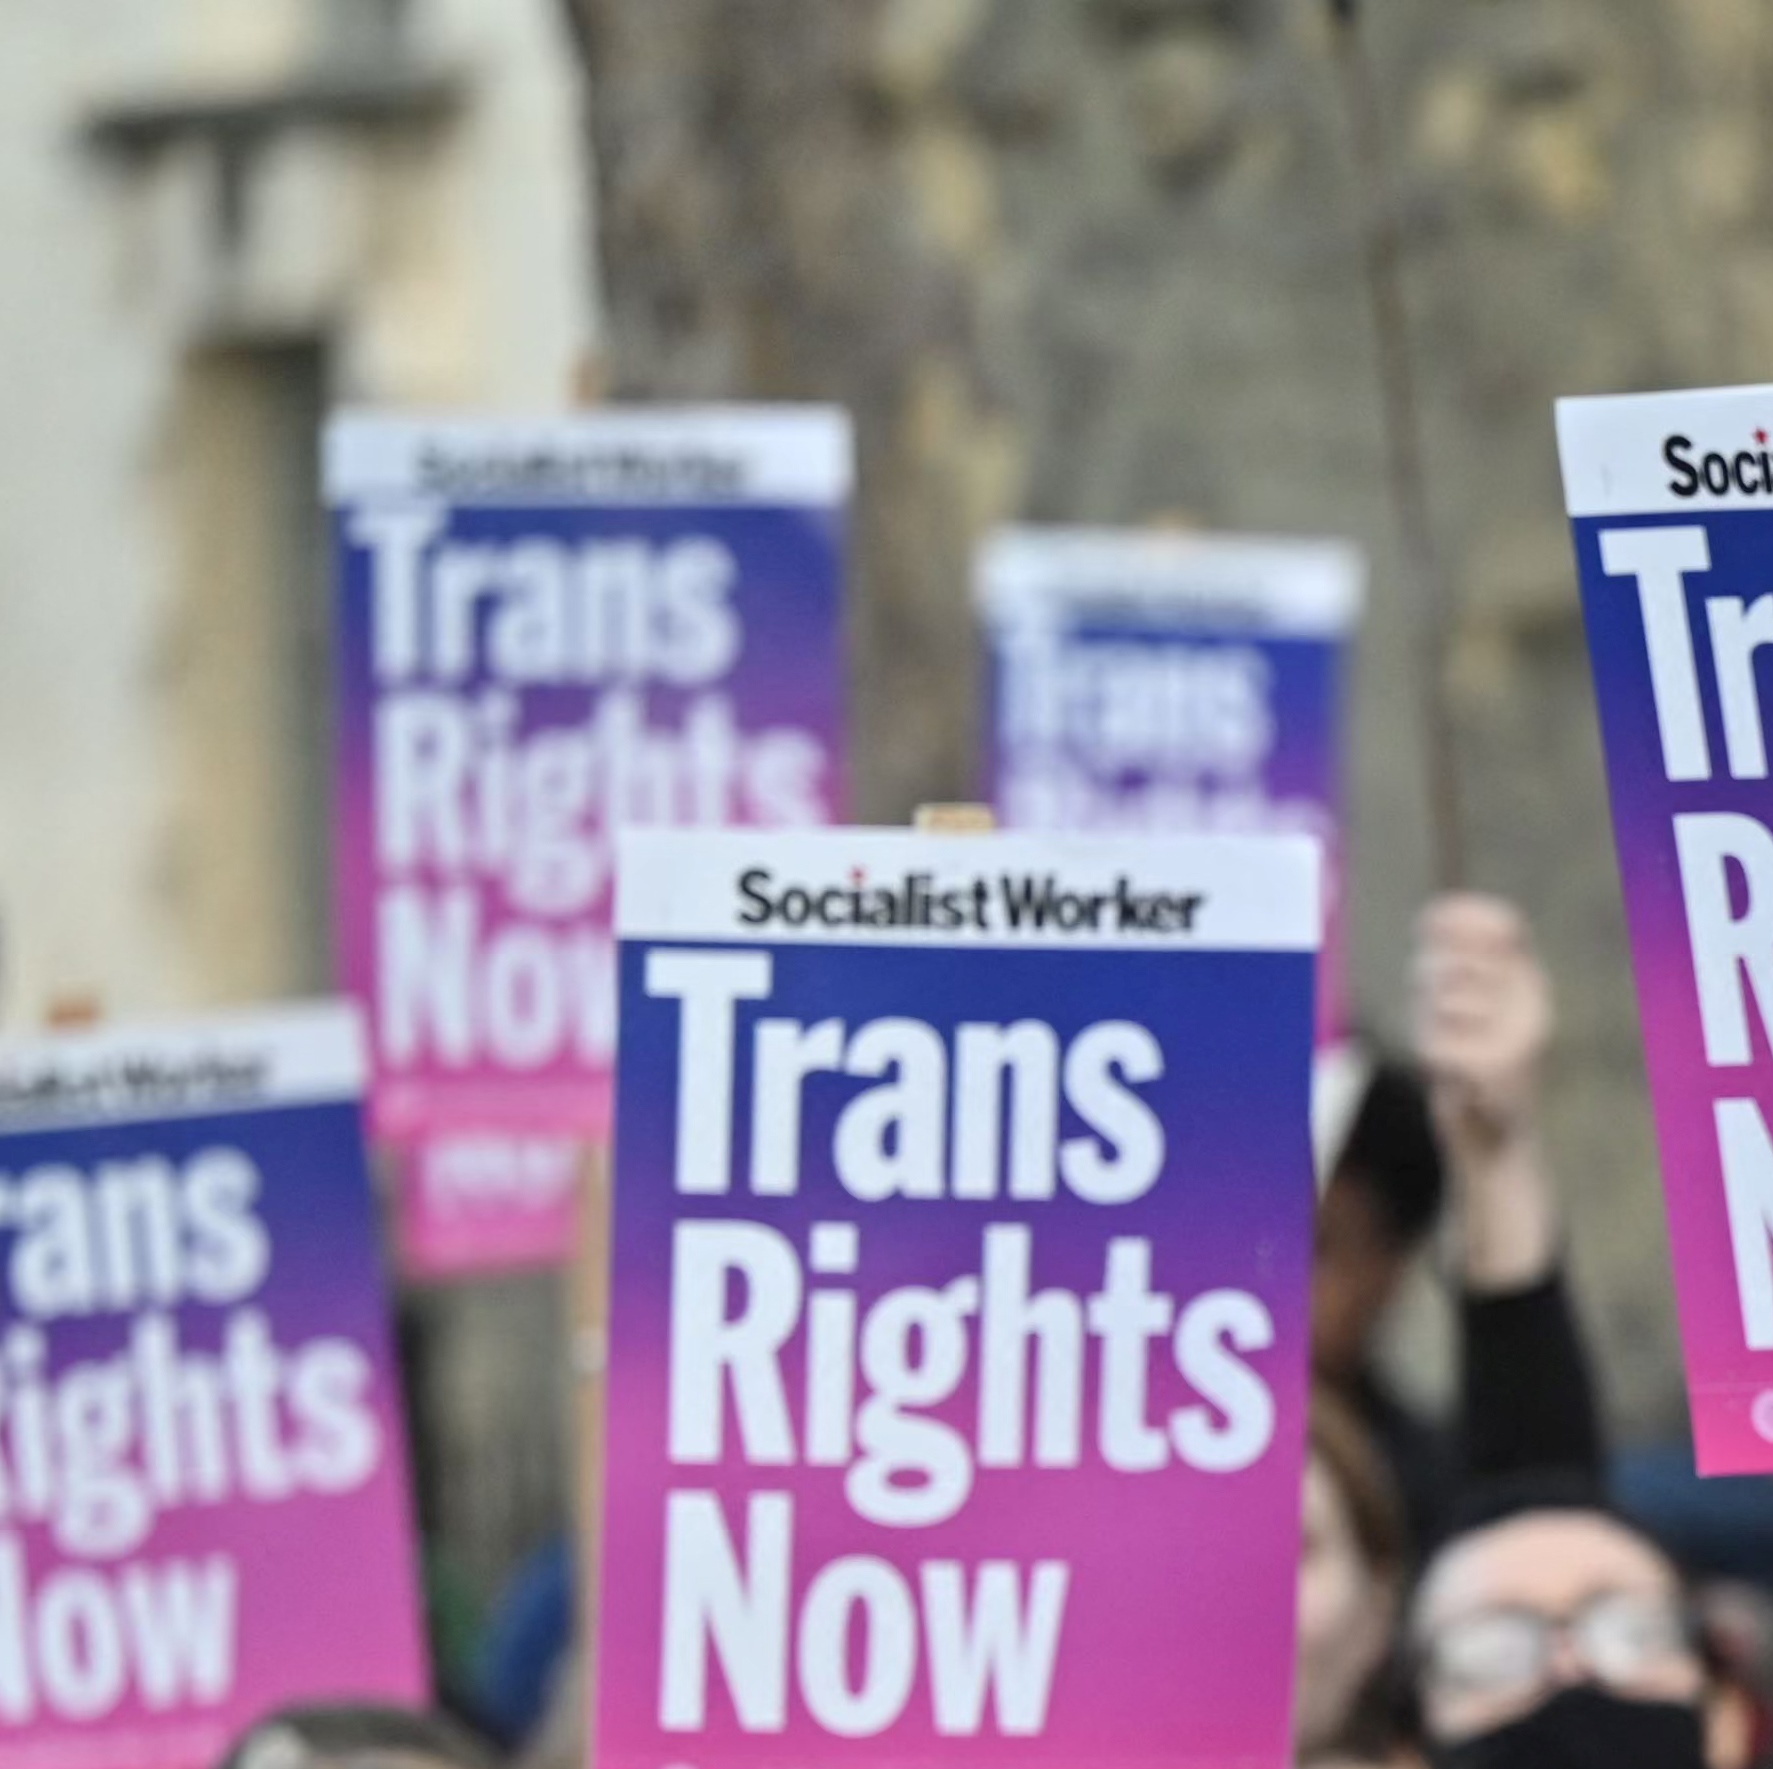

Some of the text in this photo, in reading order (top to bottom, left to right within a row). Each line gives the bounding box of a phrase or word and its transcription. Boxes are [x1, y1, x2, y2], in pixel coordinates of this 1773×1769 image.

[346, 503, 742, 687] Trans
[376, 680, 833, 918] Rights
[736, 865, 1204, 935] Socialist Worker
[644, 947, 1166, 1205] Trans
[0, 1148, 270, 1316] ans
[0, 1309, 380, 1560] ights
[667, 1216, 1275, 1527] Rights
[657, 1487, 1069, 1738] Now
